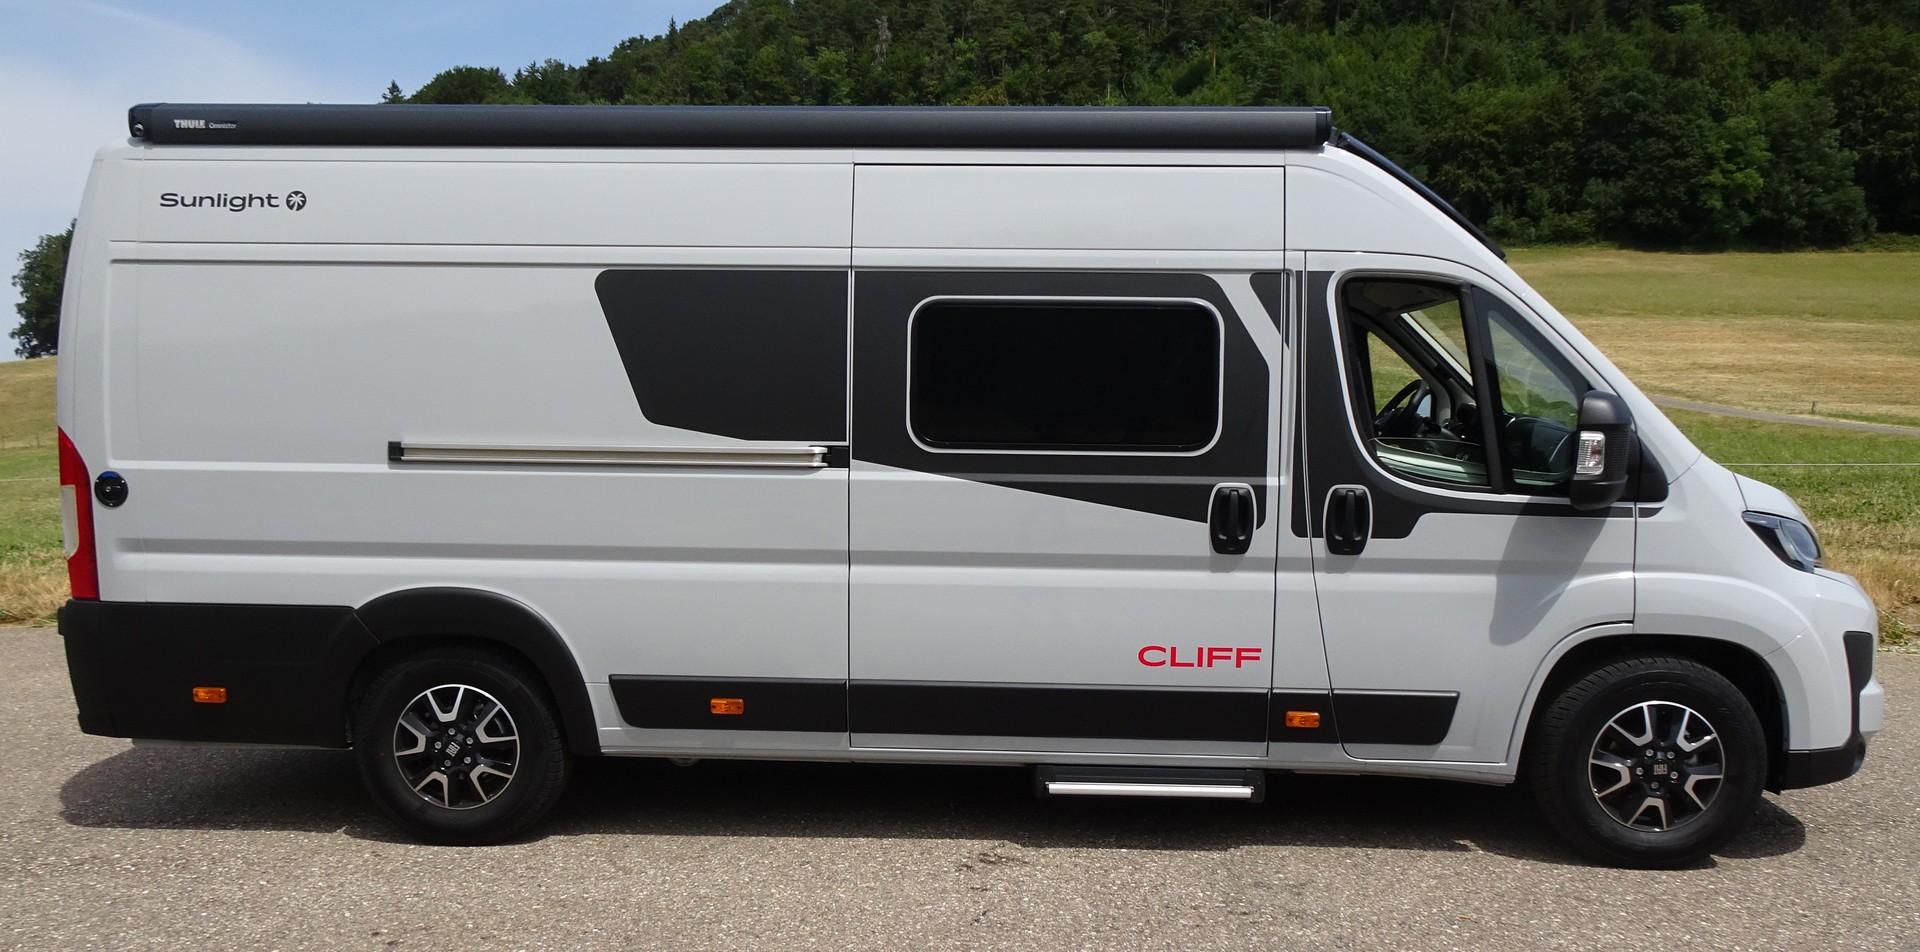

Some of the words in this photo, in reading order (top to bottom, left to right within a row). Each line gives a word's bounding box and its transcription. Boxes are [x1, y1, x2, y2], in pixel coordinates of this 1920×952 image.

[173, 119, 206, 129] THULE
[160, 193, 280, 212] Sunlight
[1138, 645, 1262, 668] CLIFF
